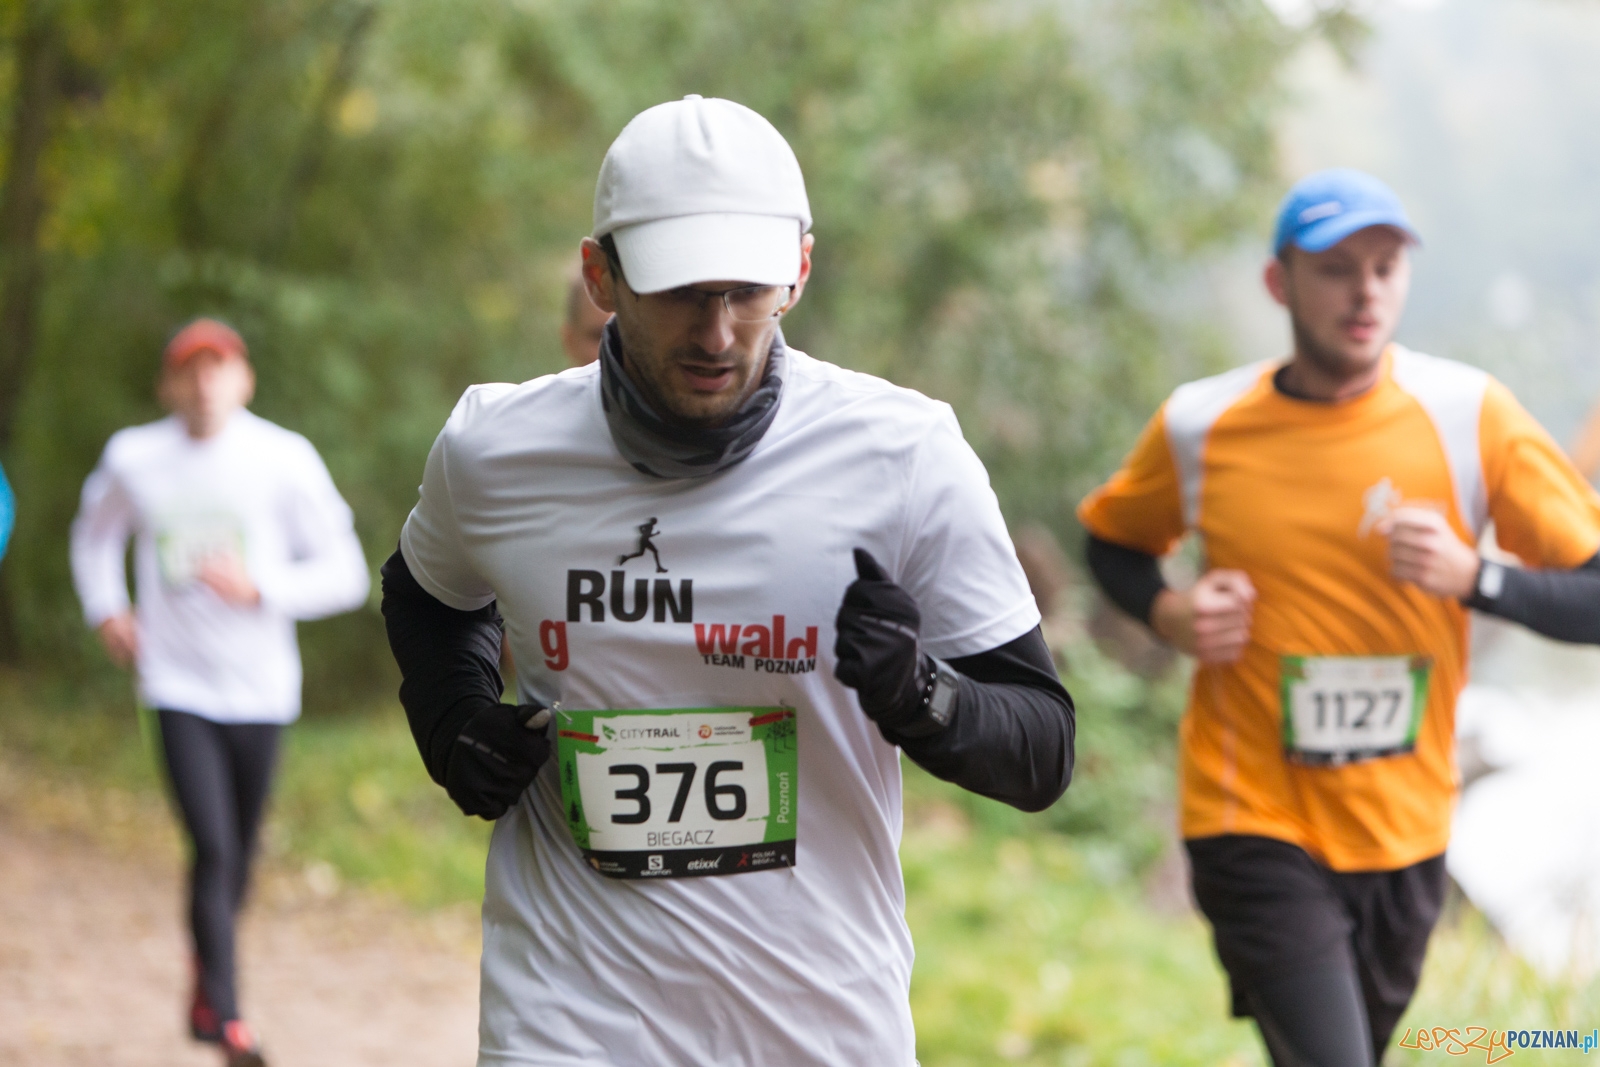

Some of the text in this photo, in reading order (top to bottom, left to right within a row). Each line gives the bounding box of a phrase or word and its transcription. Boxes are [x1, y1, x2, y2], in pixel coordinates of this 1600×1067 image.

[566, 569, 693, 623] RUN
[539, 614, 818, 671] g wald
[701, 653, 745, 669] TEAM
[1311, 690, 1403, 729] 1127
[608, 760, 747, 825] 376
[647, 830, 714, 847] BIEGACZ
